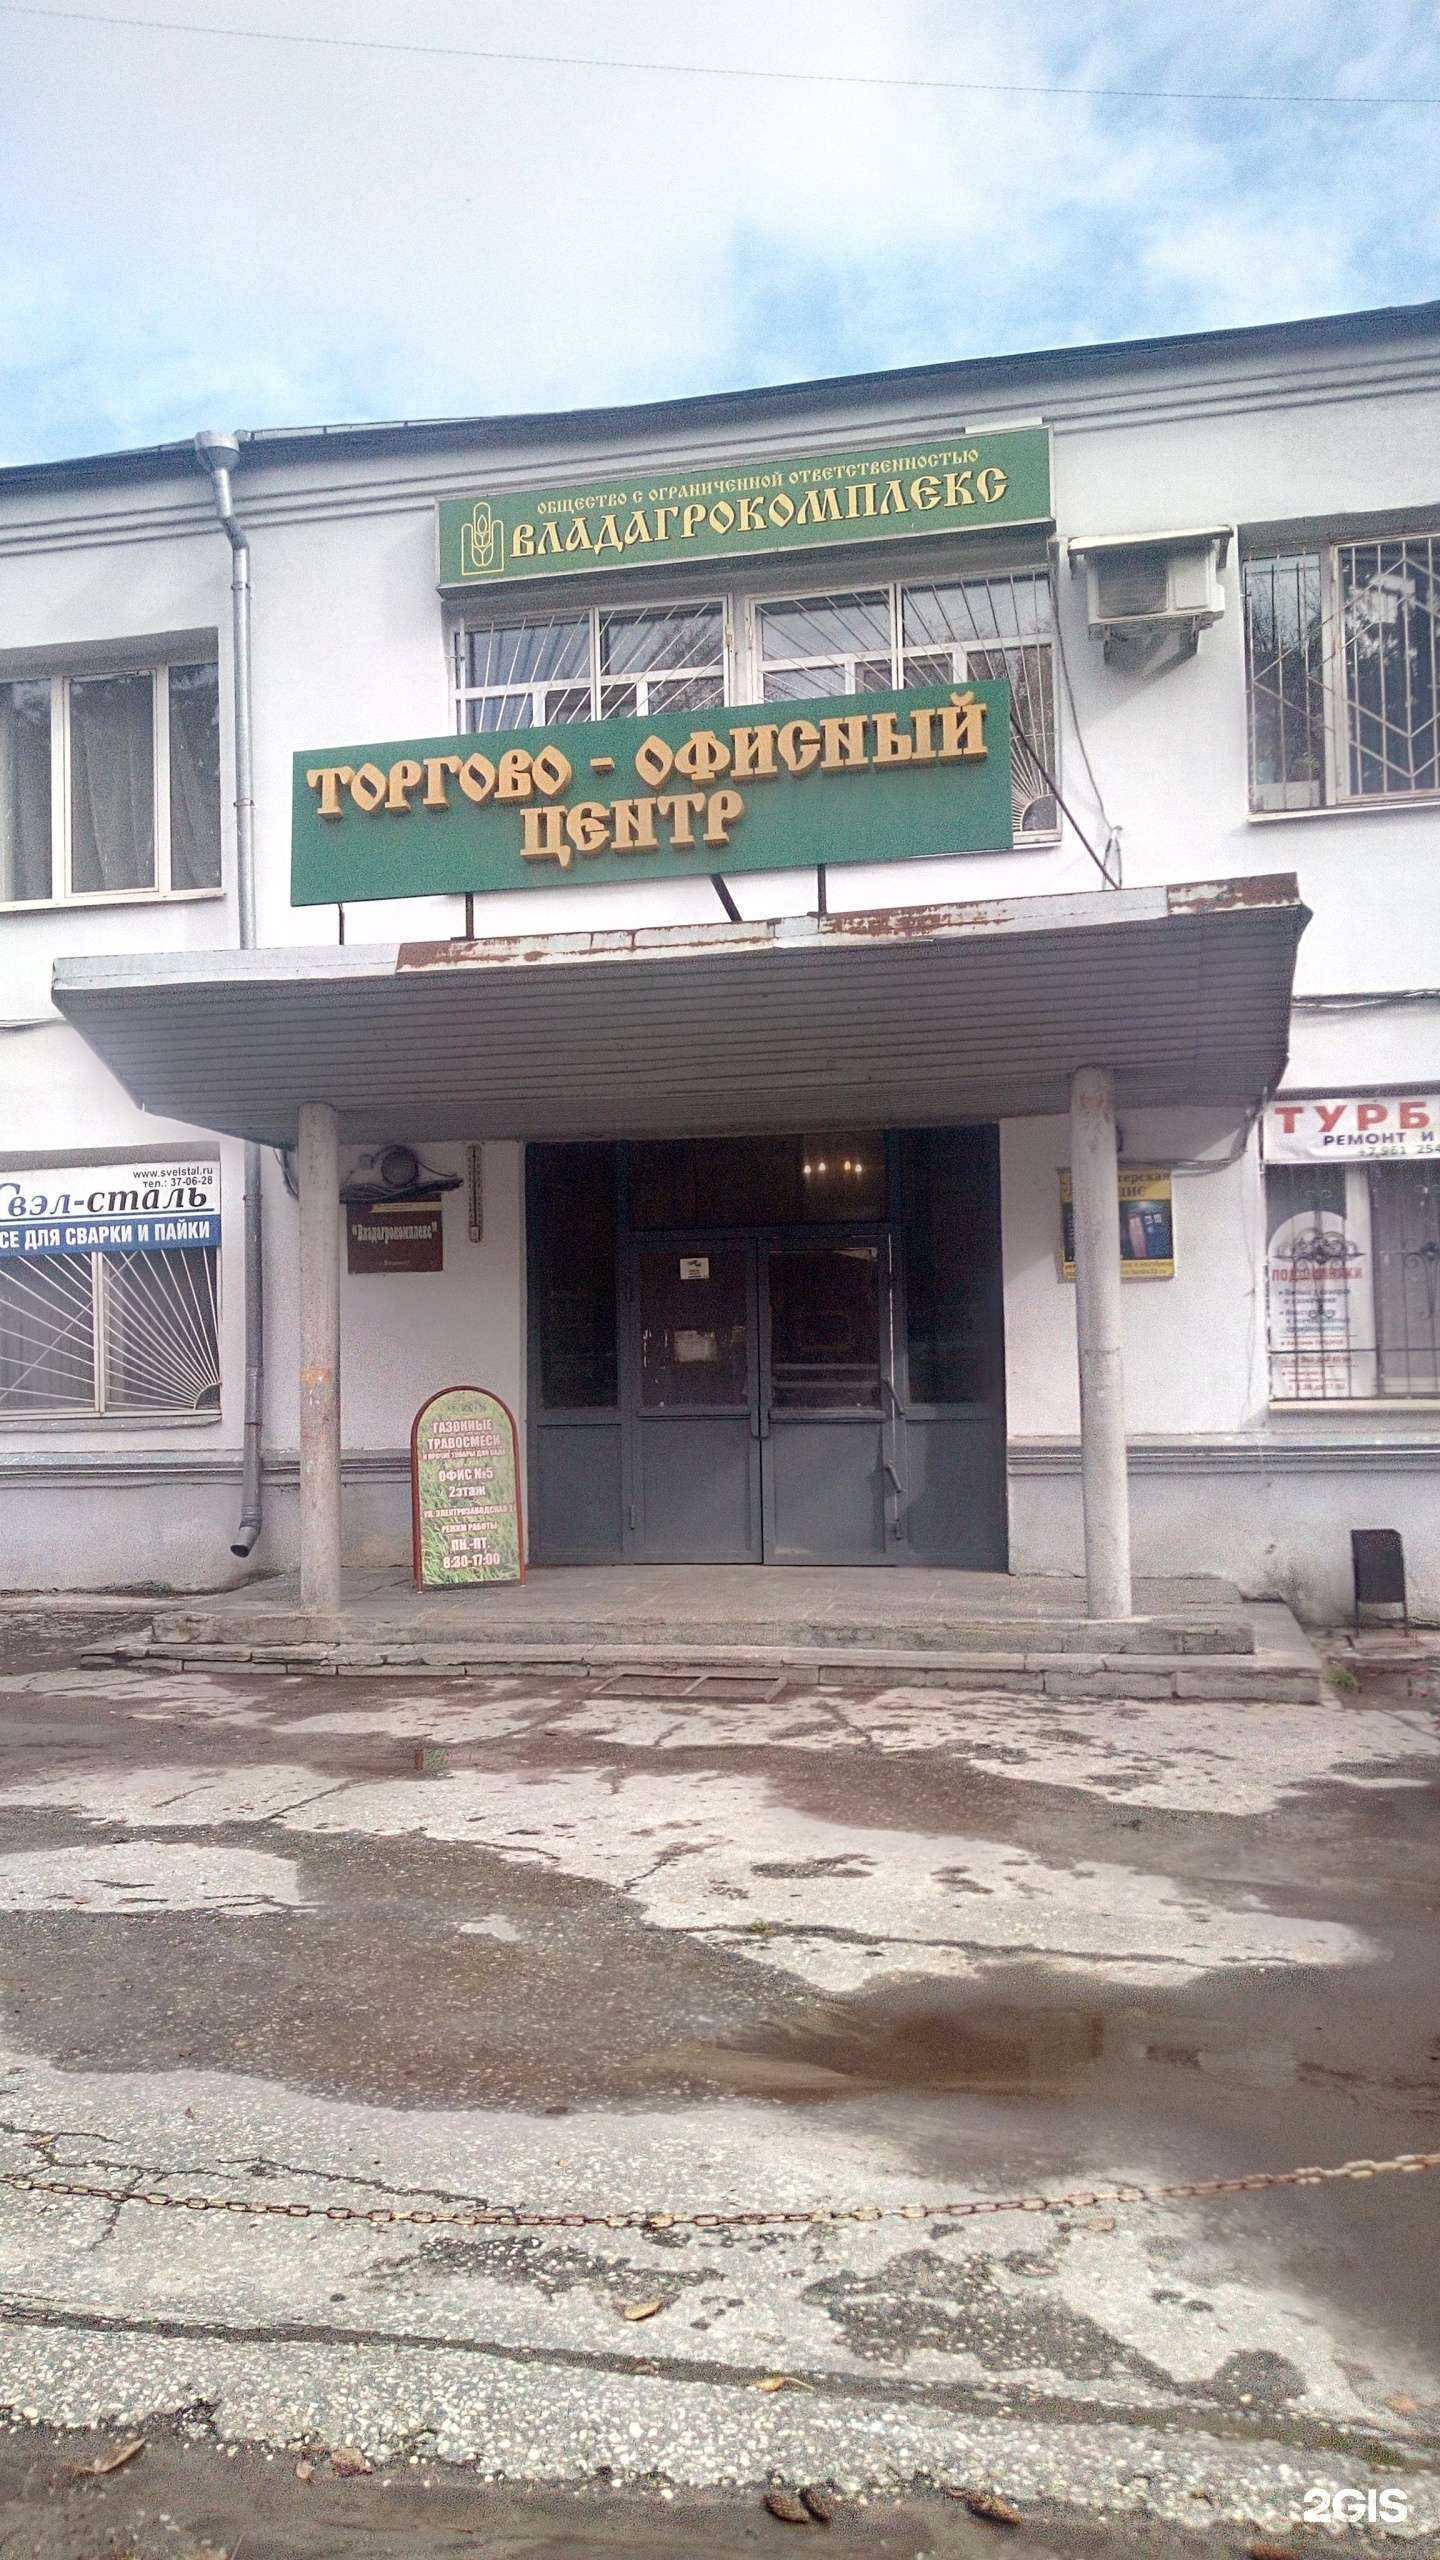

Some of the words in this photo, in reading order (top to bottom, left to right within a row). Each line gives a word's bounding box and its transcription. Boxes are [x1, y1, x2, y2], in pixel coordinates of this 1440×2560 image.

[537, 491, 628, 515] ОБЩЕСТВО
[632, 490, 643, 505] С
[648, 470, 784, 502] ОГРАНИЧЕННОЙ
[788, 449, 981, 482] ОТВЕТСТВЕННОСТЬЮ
[509, 466, 1009, 559] ВЛАДАГРОКОМПЛЕКС
[307, 745, 572, 820] ТОРГОВО
[635, 692, 990, 787] ОФИСНЫЙ
[519, 789, 746, 871] ЦЕНТР
[1274, 1101, 1431, 1134] ТУРБ
[1323, 1133, 1406, 1146] РЕМОНТ
[1421, 1131, 1434, 1142] И
[133, 1166, 213, 1179] www.svelstal.ru
[170, 1175, 213, 1187] 37-06-28
[25, 1228, 60, 1250] ДЛЯ
[65, 1225, 133, 1245] СВАРКИ
[138, 1224, 149, 1241] И
[155, 1218, 210, 1241] ПАЙКИ
[432, 1418, 493, 1433] ГАЗОННЫЕ
[427, 1434, 501, 1450] ТРАВОСМЕСИ
[439, 1468, 473, 1482] ОФИС
[474, 1467, 494, 1480] №5
[443, 1553, 500, 1569] 8:30-17:00
